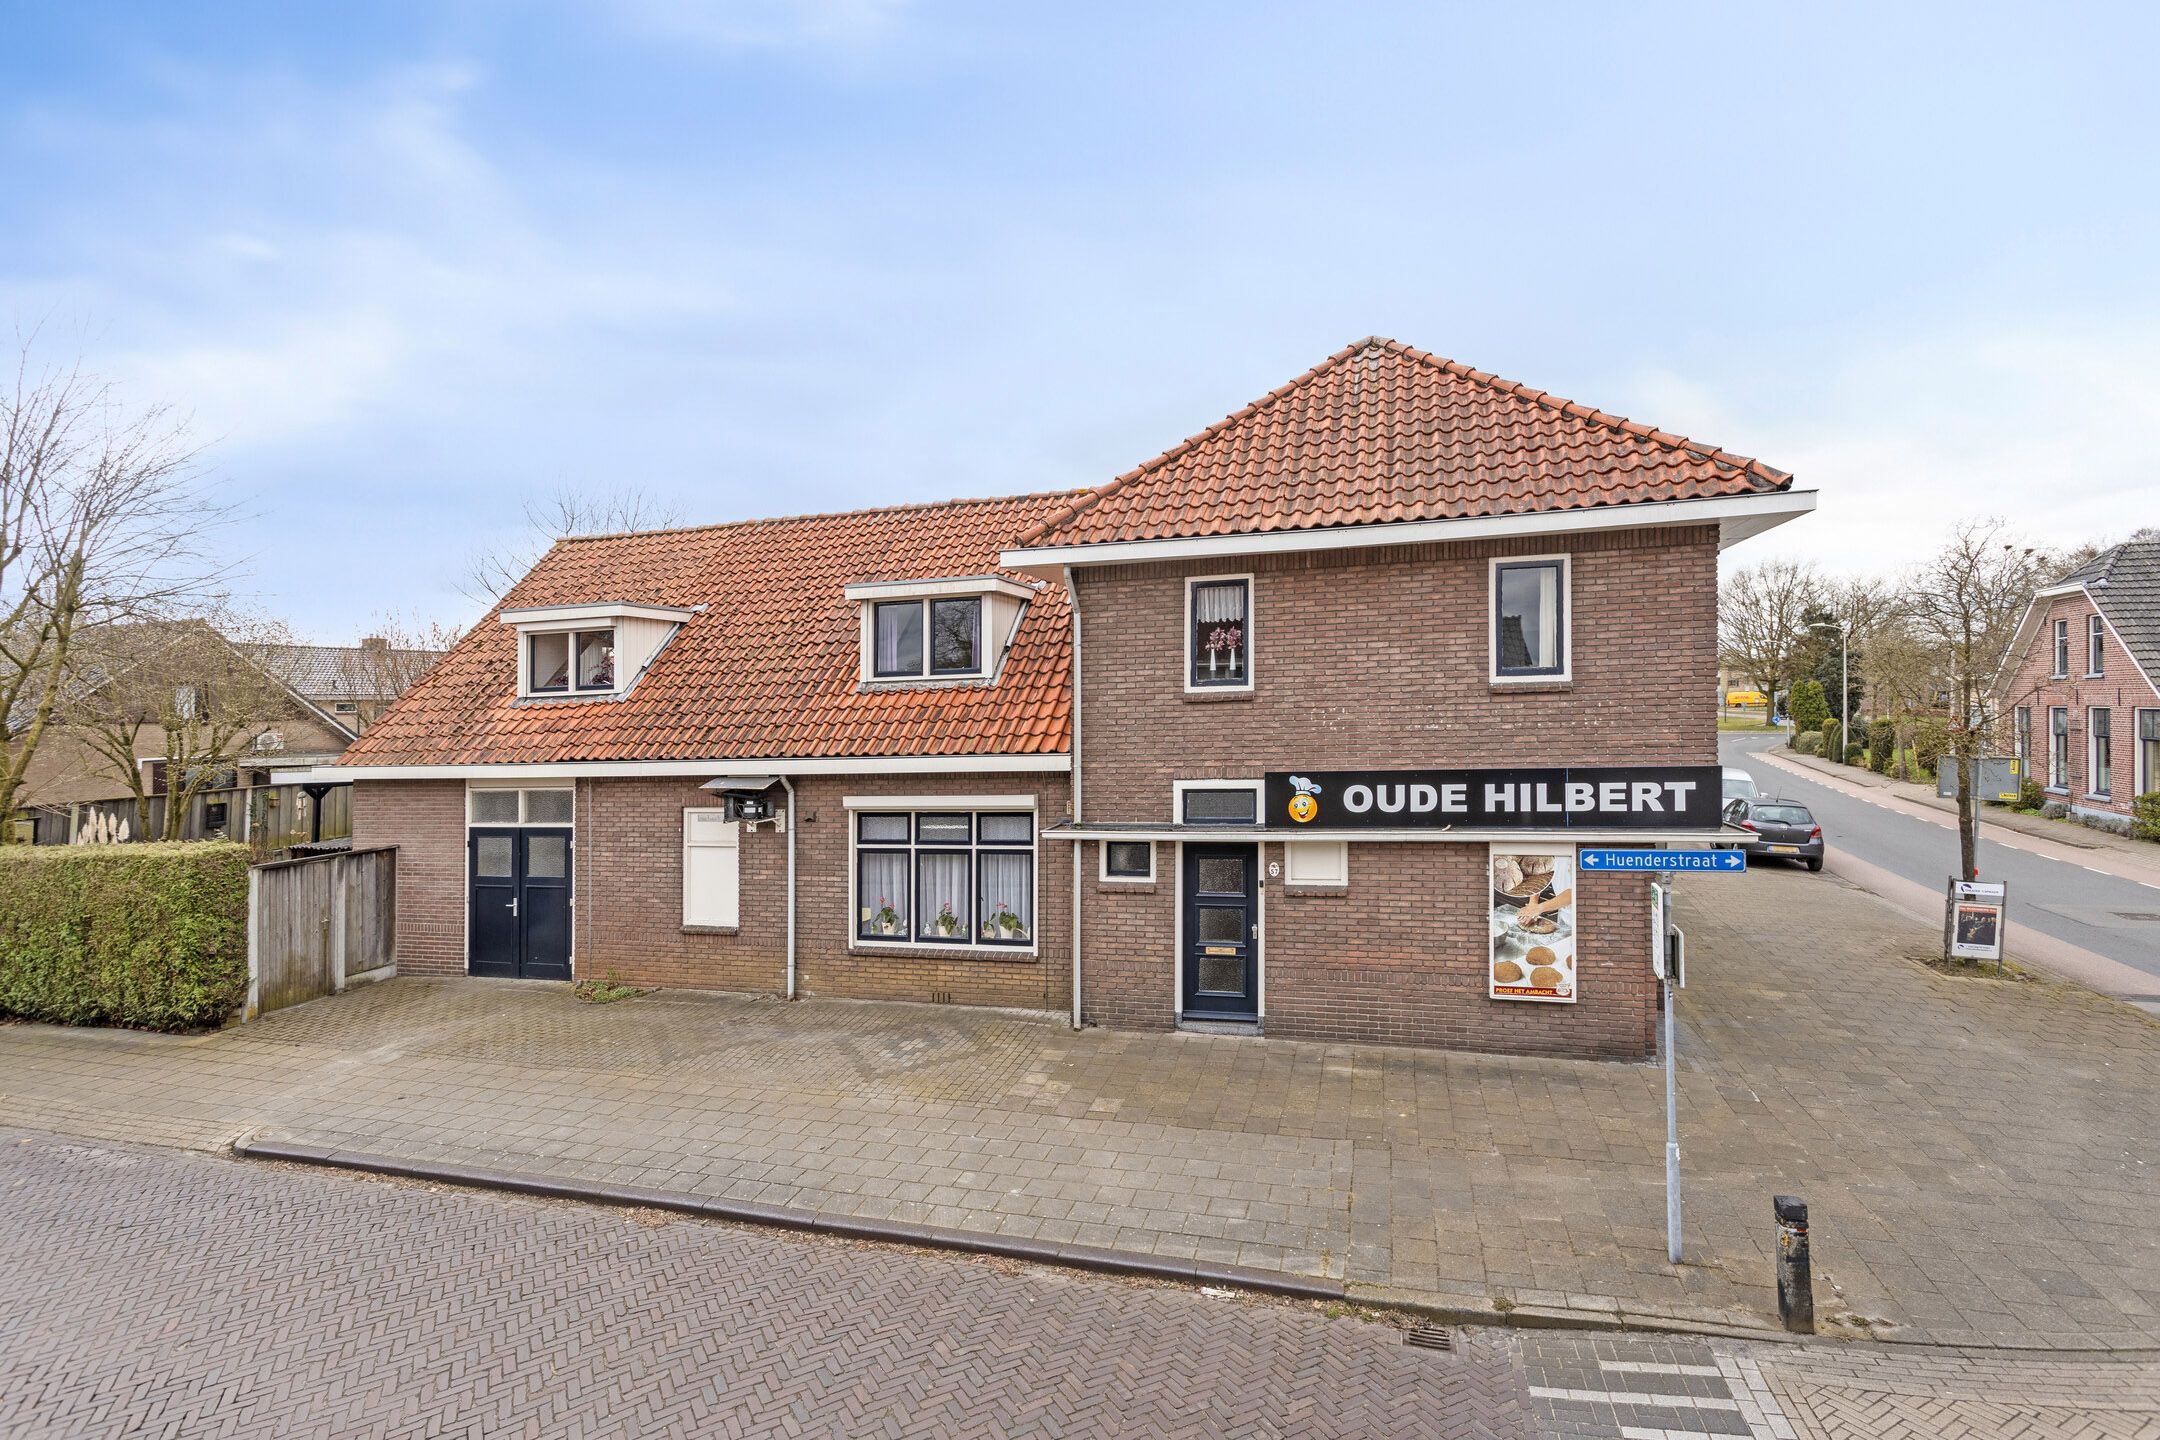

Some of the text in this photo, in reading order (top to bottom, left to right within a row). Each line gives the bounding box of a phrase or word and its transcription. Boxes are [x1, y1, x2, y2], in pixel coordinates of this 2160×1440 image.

[1343, 781, 1696, 813] OUDE HILBERT
[1605, 853, 1718, 868] Huenderstraat
